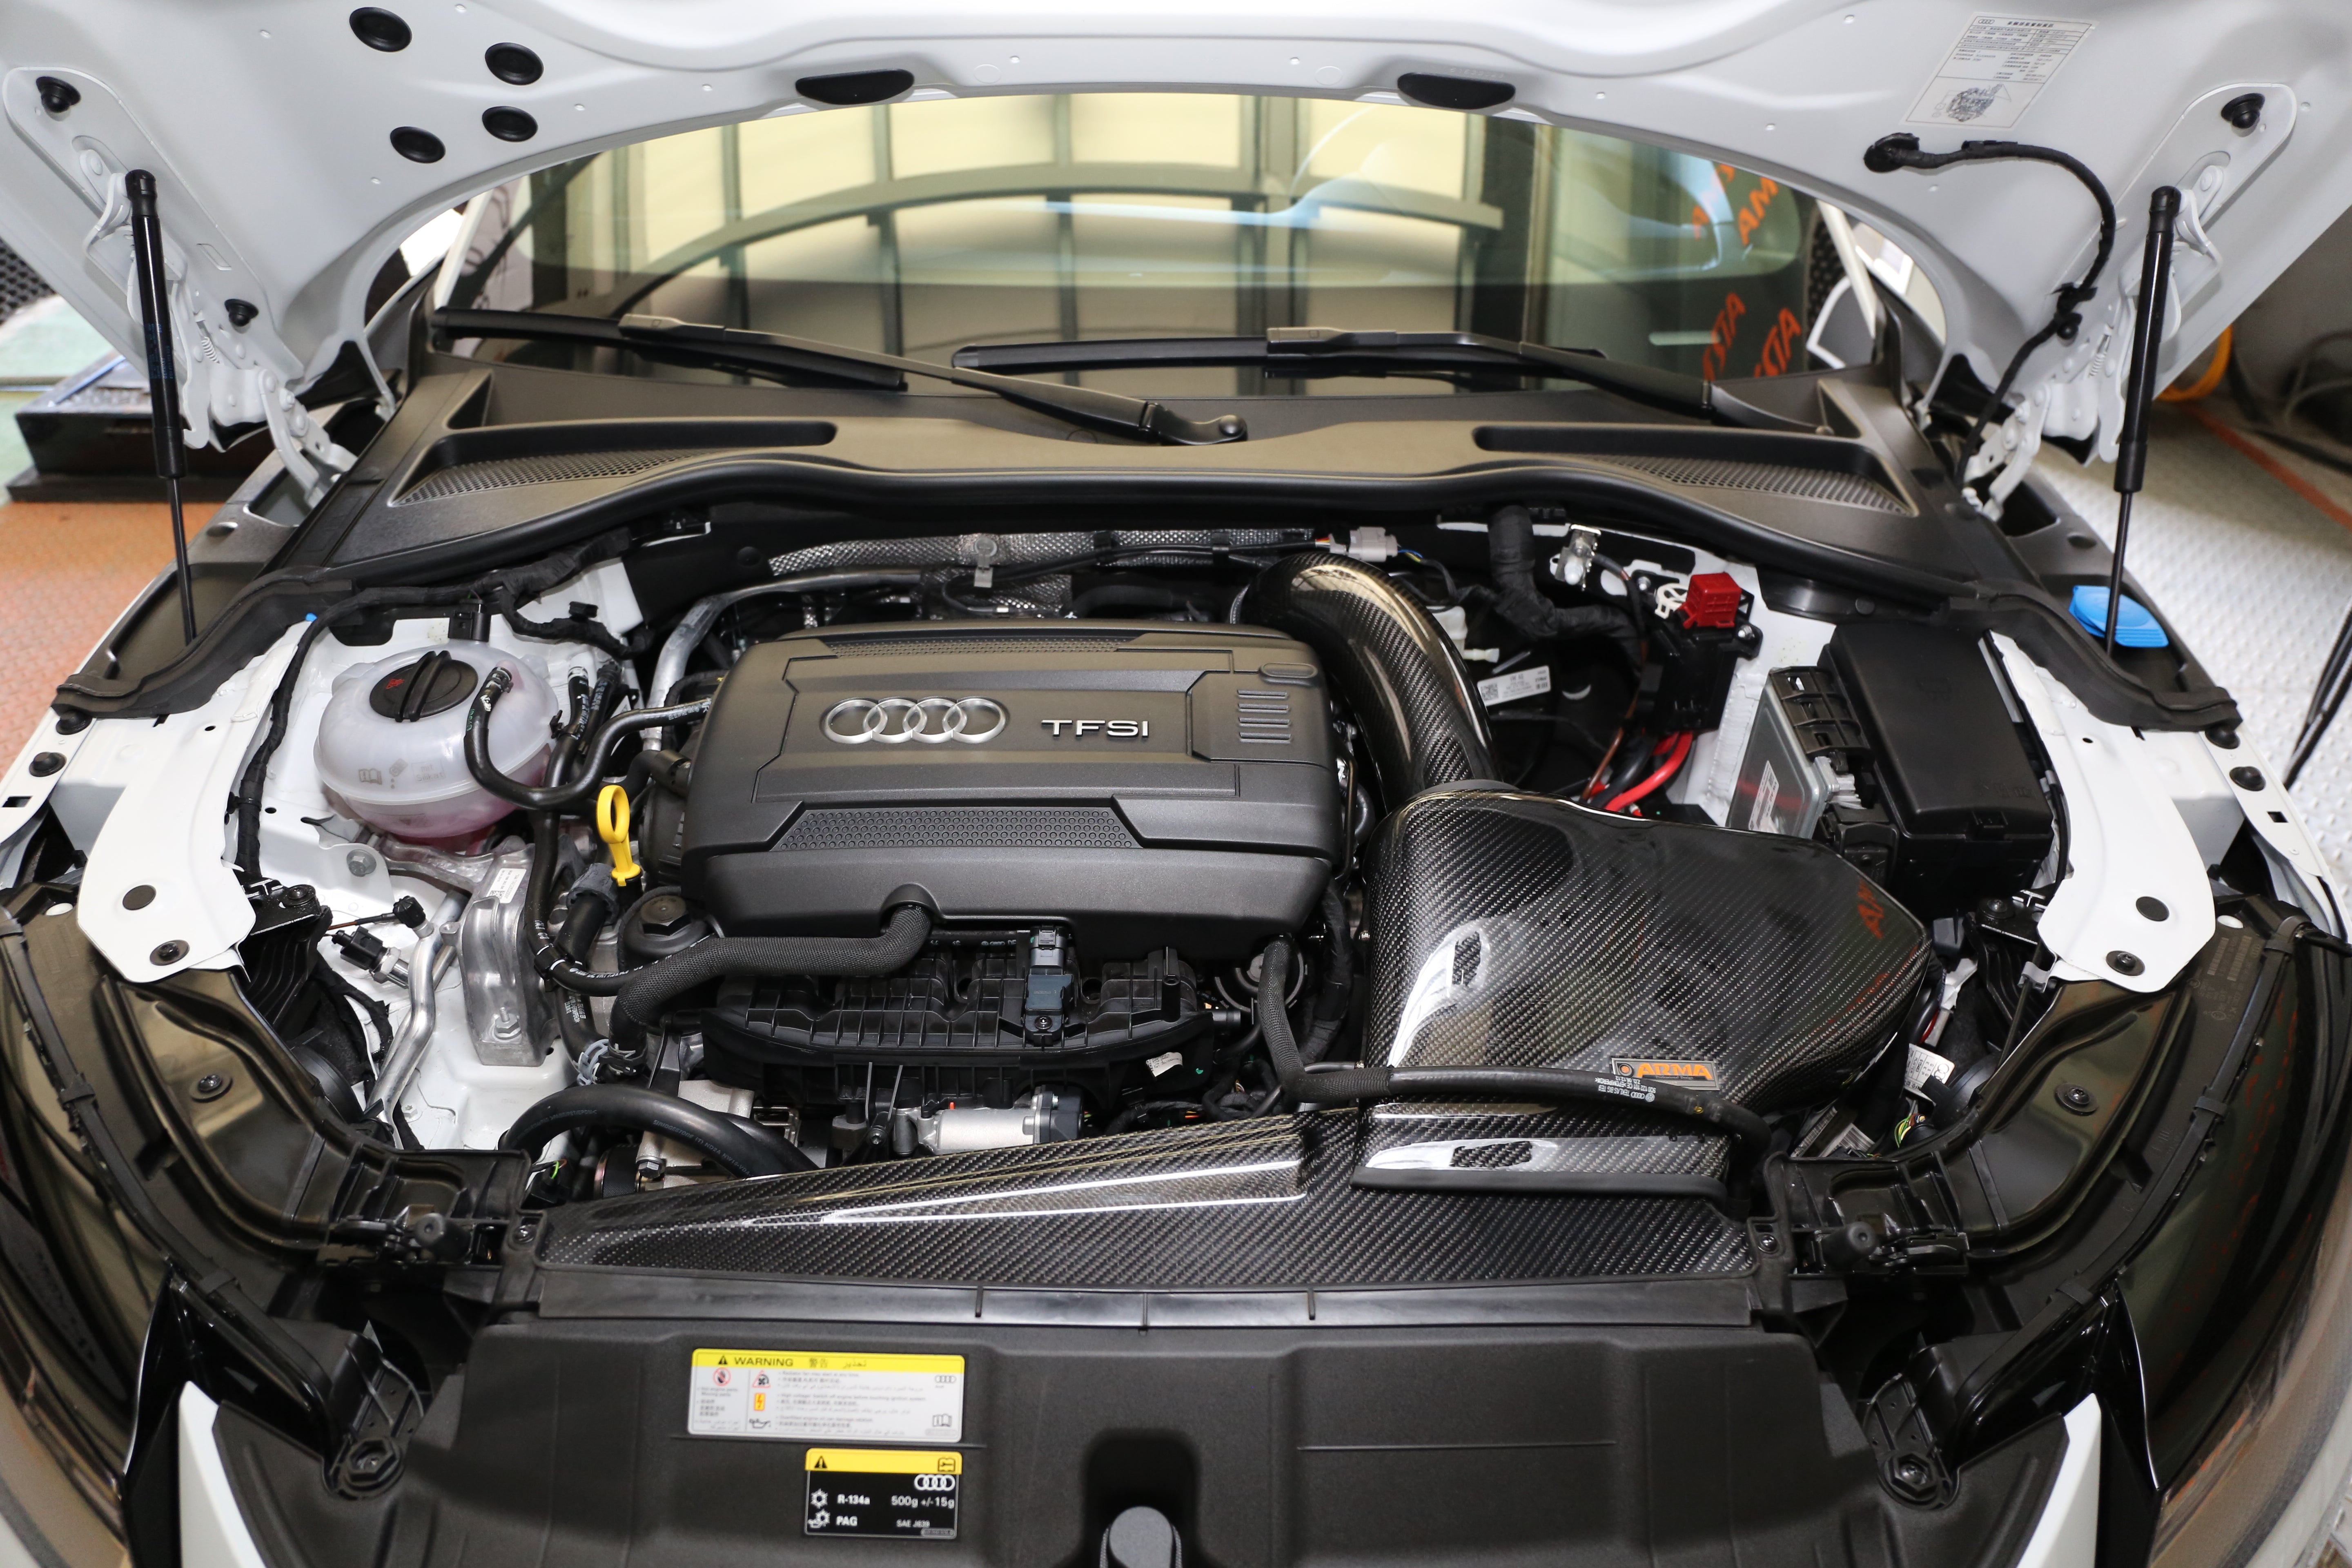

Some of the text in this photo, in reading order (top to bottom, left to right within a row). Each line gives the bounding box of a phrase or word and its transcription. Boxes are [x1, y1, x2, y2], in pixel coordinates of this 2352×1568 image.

[1042, 719, 1149, 737] TFSI
[1637, 1063, 1713, 1080] ARMA
[1614, 1087, 1630, 1096] TEKLAS
[653, 1119, 694, 1139] BRIDGESTONE
[704, 1142, 722, 1155] ND2A
[734, 1357, 793, 1367] WARNING
[837, 1494, 871, 1505] R-134a
[891, 1495, 918, 1508] 500g
[836, 1516, 858, 1526] PAG
[896, 1519, 911, 1528] SAE
